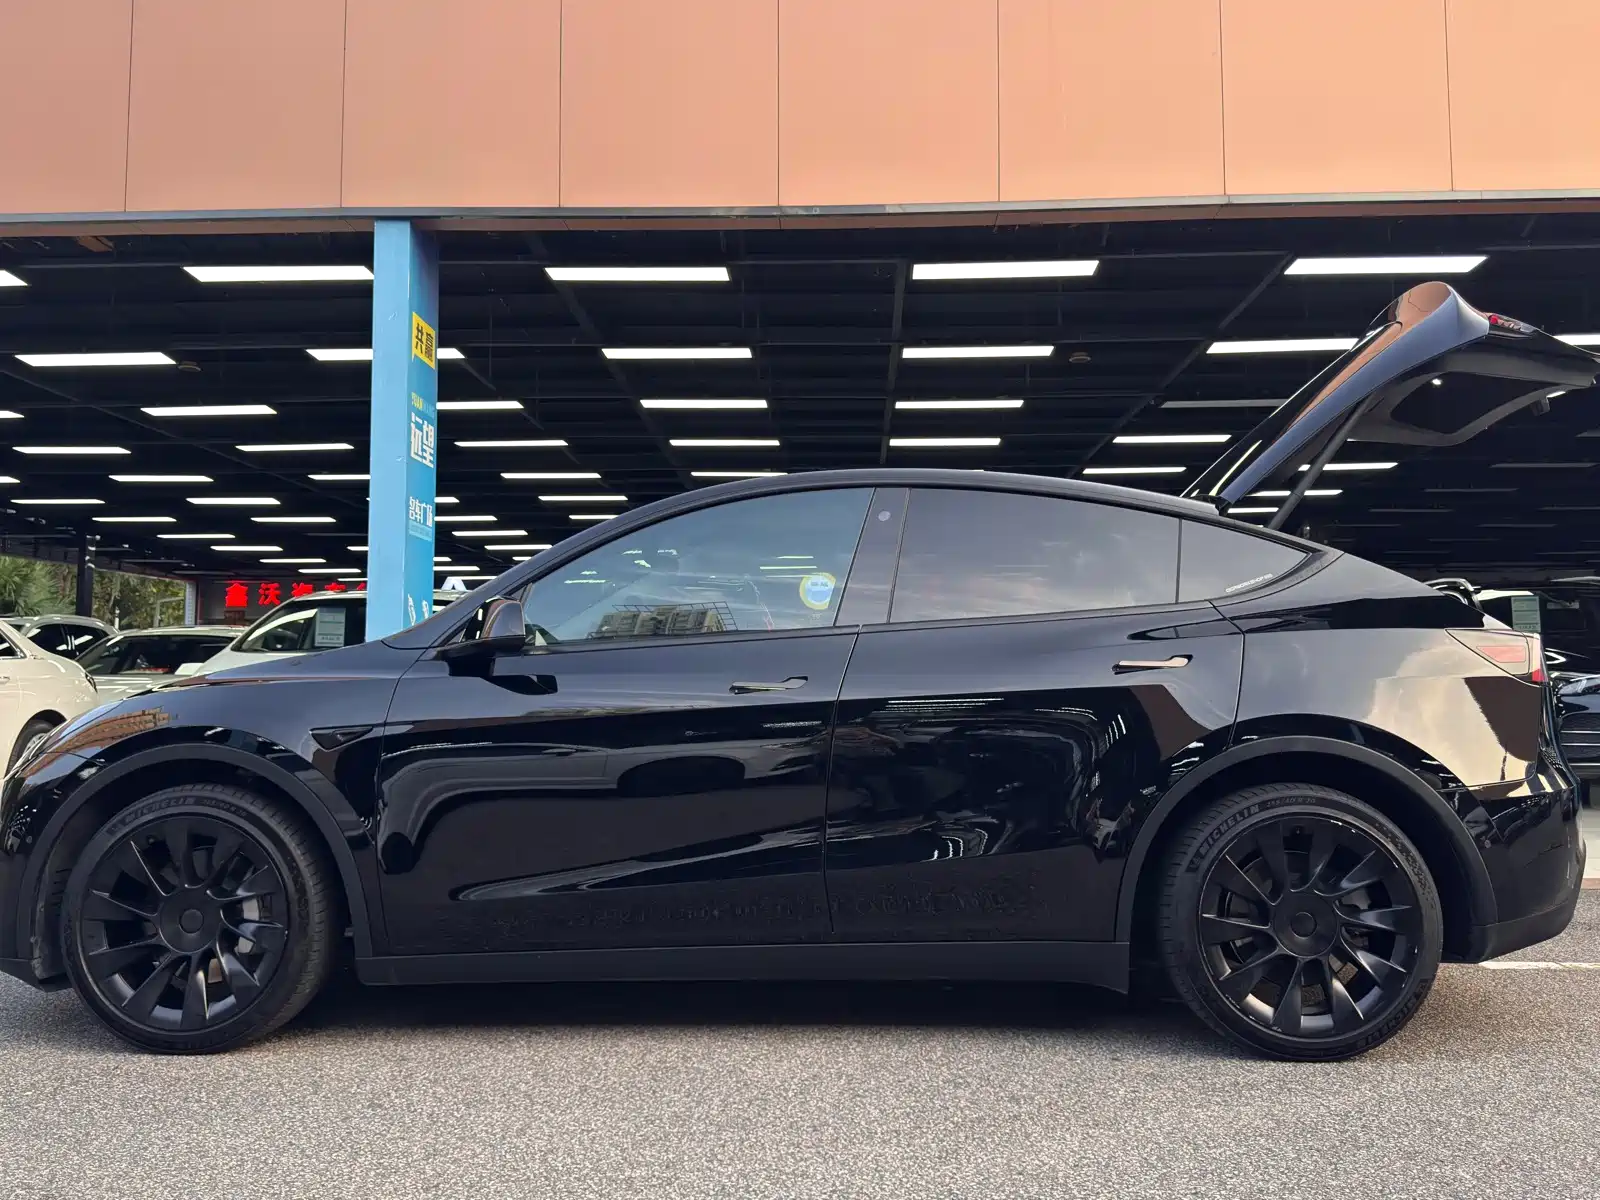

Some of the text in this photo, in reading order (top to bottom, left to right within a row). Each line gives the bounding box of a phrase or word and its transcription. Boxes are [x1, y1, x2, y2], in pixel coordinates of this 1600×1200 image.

[415, 322, 434, 362] 共赢
[410, 411, 434, 469] 远望
[409, 496, 433, 528] 名车广场
[1199, 804, 1260, 855] MICHELIN
